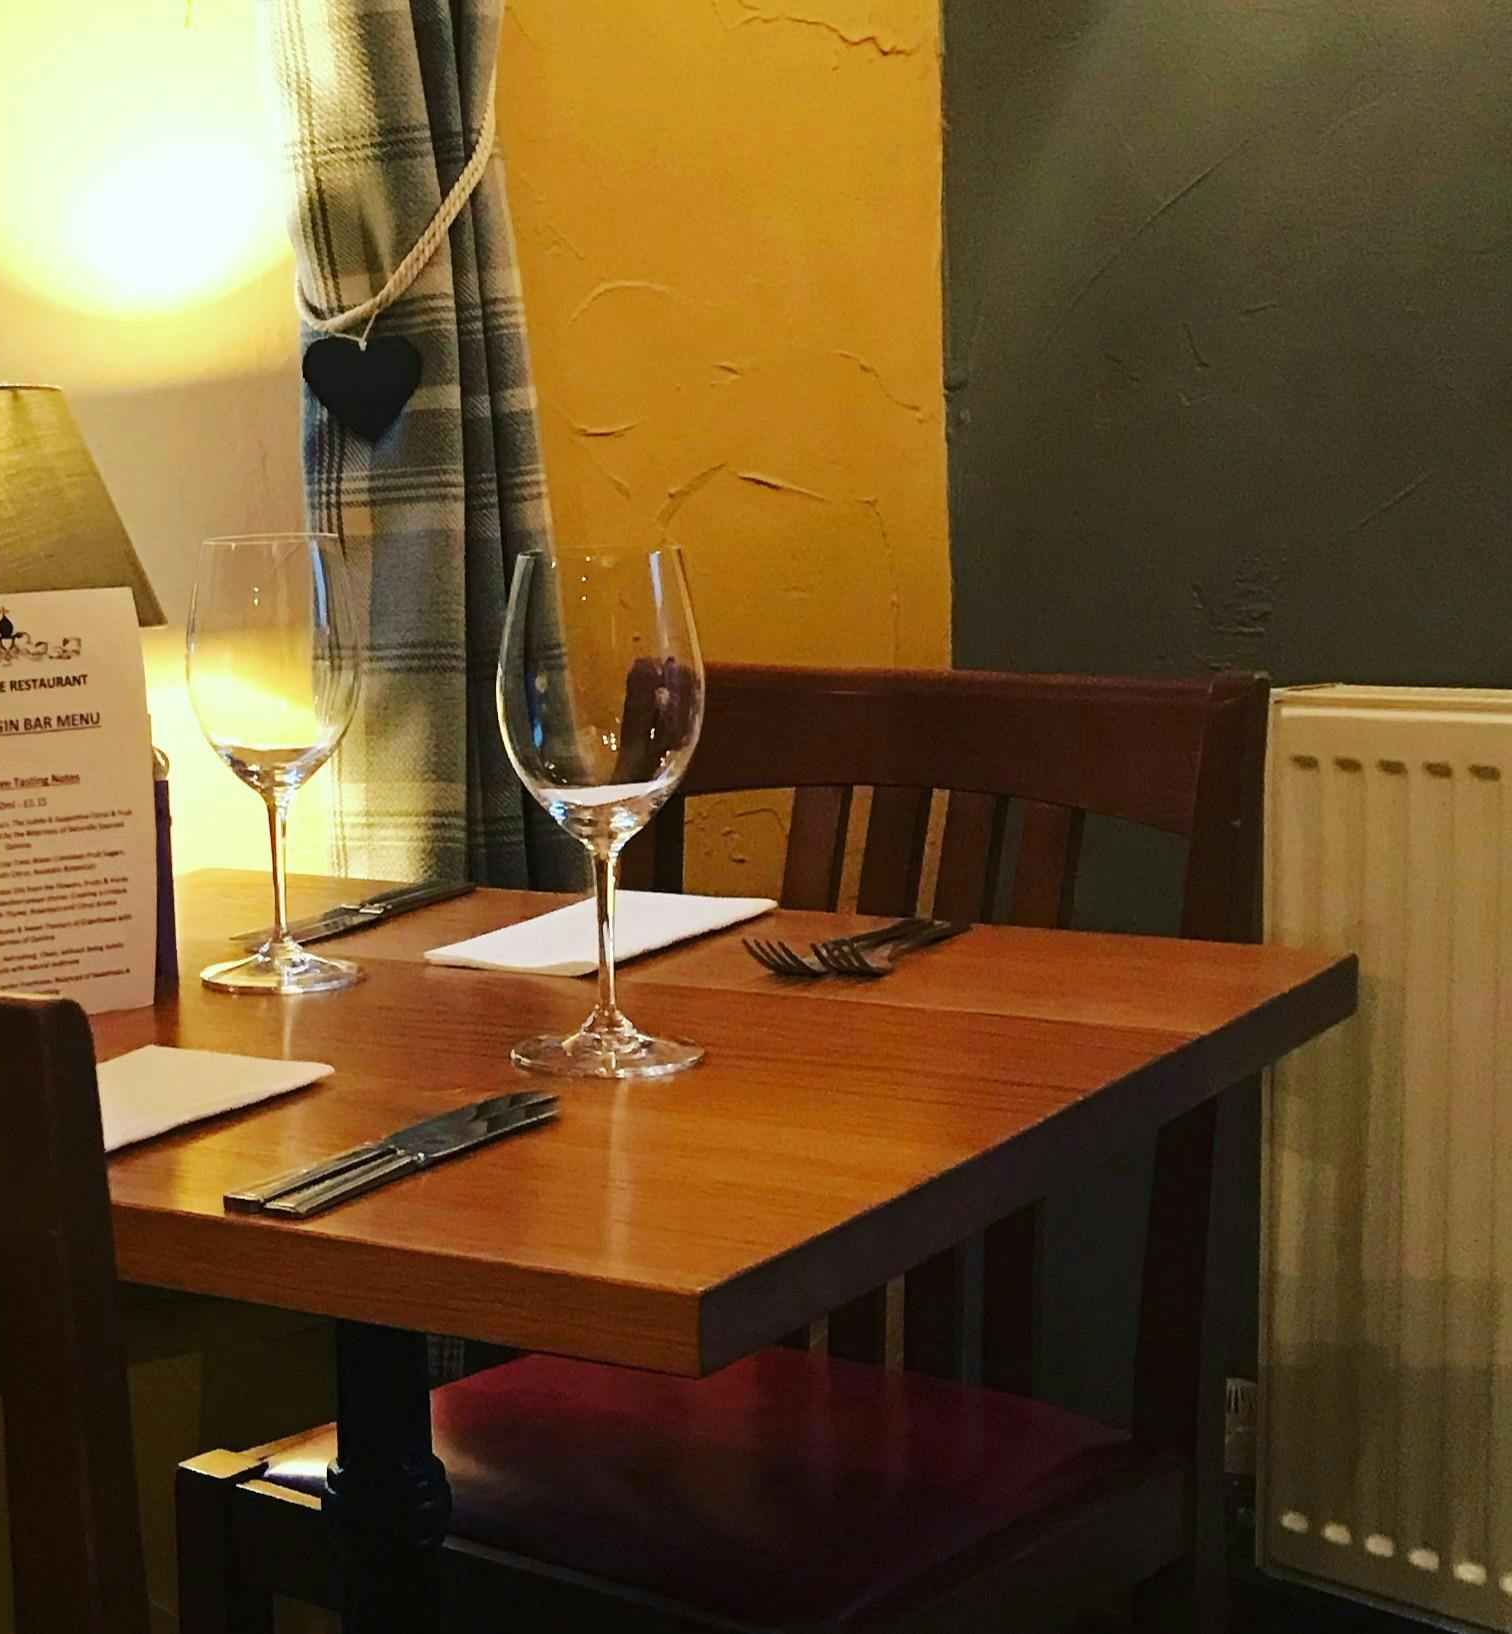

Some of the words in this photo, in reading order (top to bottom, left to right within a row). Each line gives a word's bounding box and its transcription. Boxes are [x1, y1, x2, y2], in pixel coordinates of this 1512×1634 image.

[9, 674, 89, 692] RESTAURANT
[23, 715, 53, 732] BAR
[56, 711, 101, 730] MENU
[14, 776, 50, 789] Tasting
[51, 773, 81, 785] Notes
